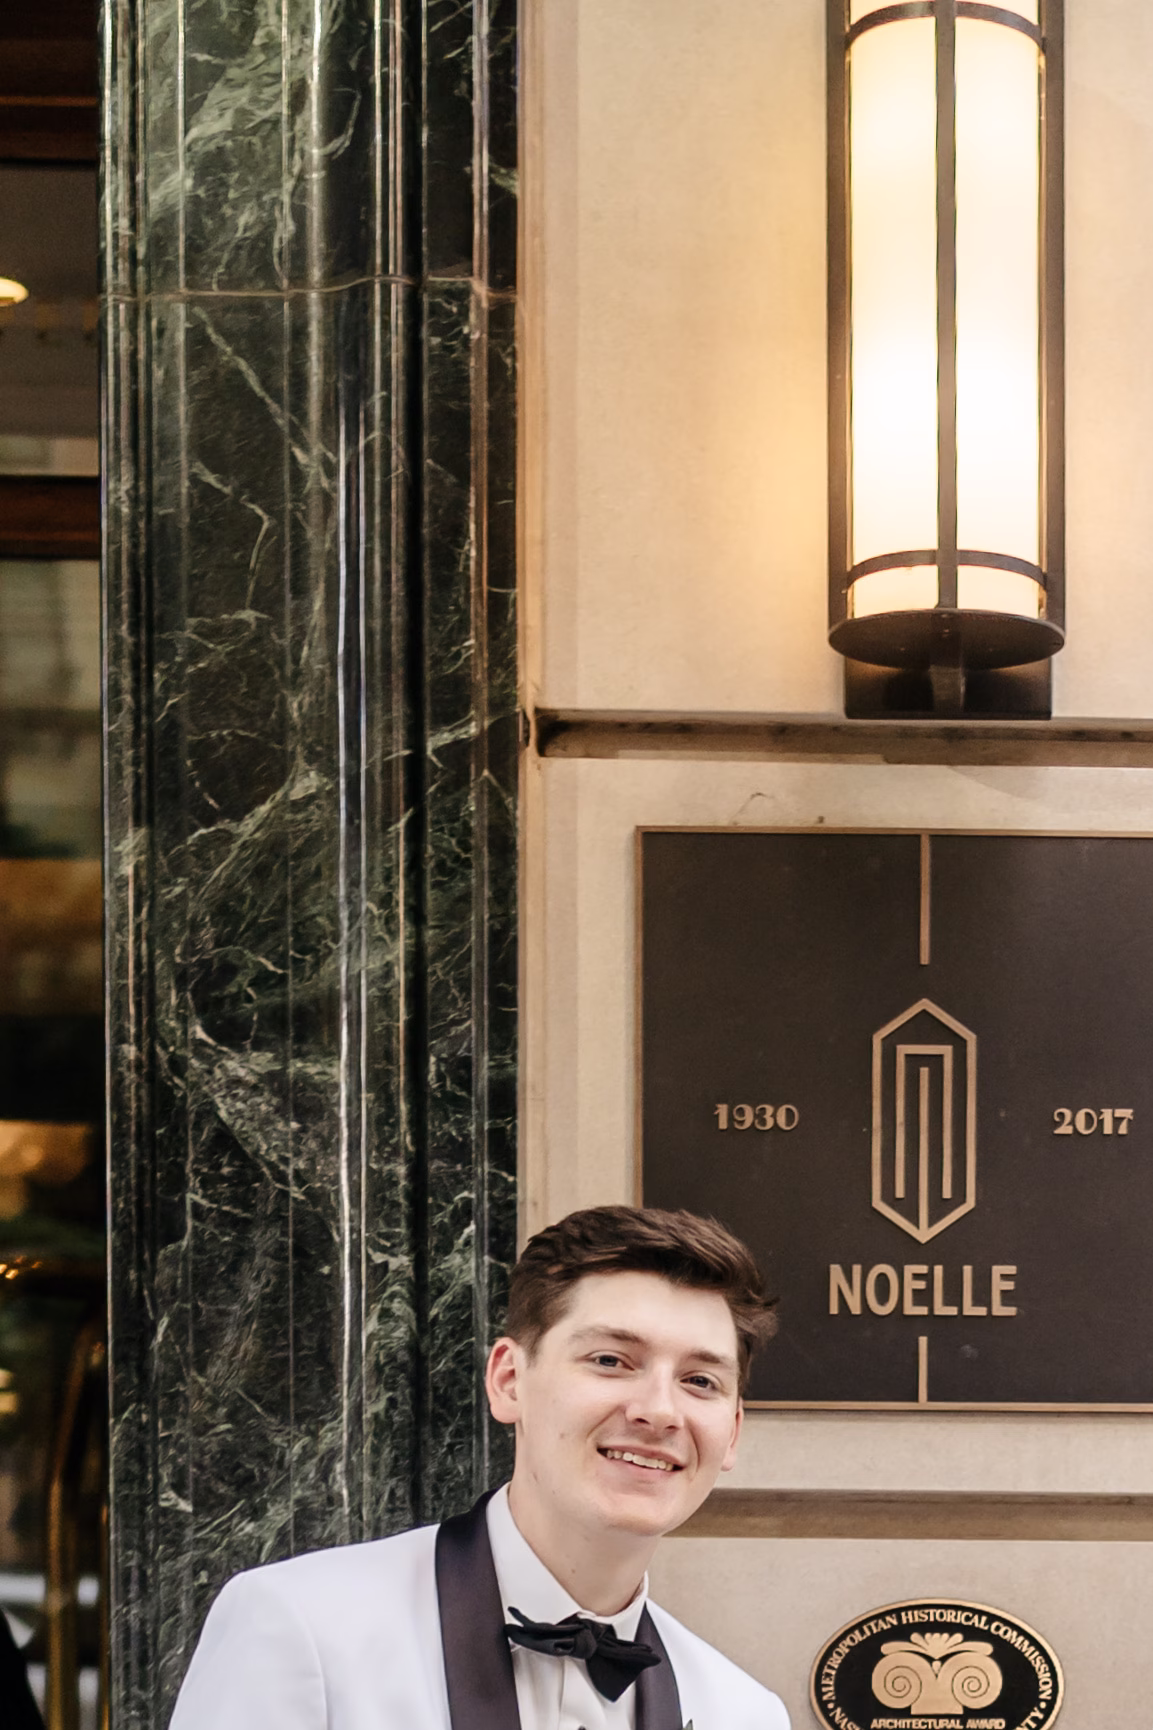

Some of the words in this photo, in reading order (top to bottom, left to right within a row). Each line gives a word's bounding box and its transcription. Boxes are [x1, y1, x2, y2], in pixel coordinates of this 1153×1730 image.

[714, 1104, 799, 1131] 1930
[1052, 1108, 1134, 1136] 2017
[829, 1263, 1018, 1317] NOELLE
[821, 1613, 899, 1702] METROPOLITAN
[901, 1608, 989, 1631] HISTORICAL
[990, 1621, 1053, 1701] COMMISSION
[870, 1718, 964, 1730] ARCHITECTURAL
[966, 1718, 1006, 1730] AWARD
